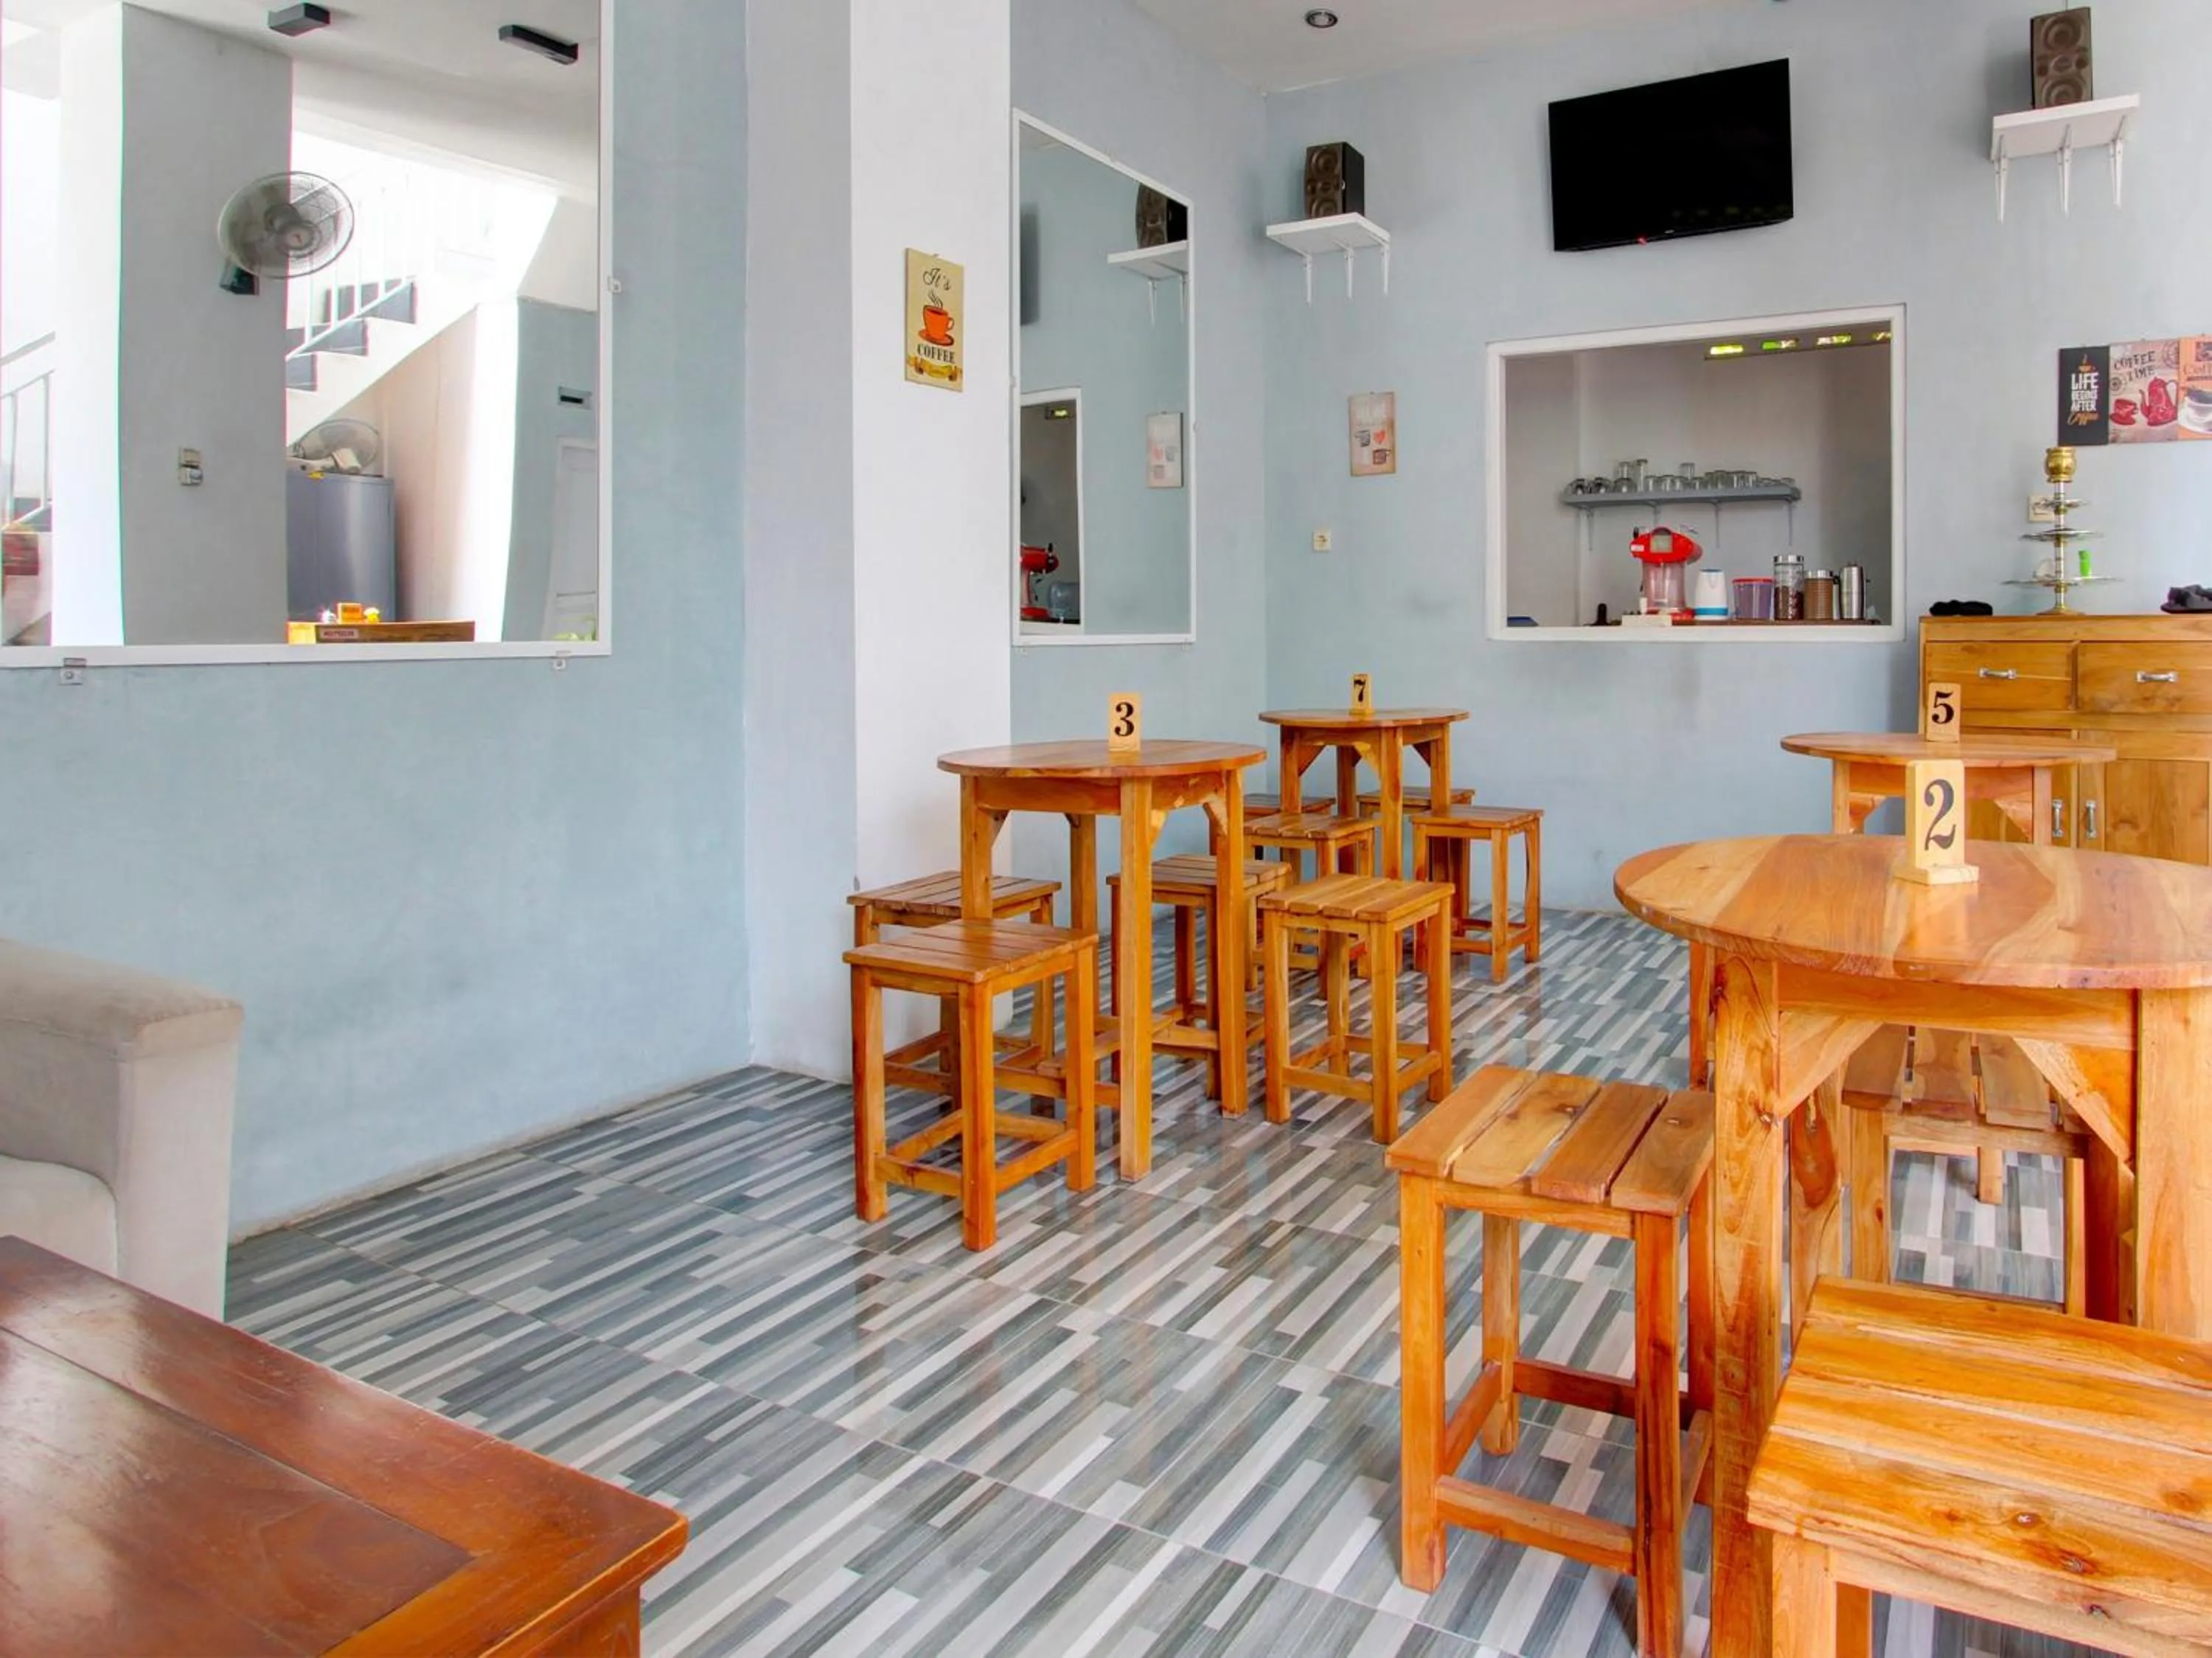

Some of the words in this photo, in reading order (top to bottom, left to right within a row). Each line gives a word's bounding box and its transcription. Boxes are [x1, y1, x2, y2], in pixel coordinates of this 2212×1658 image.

[917, 343, 956, 364] COFFEE
[2113, 350, 2155, 370] COFFEE
[2071, 372, 2099, 389] LIFE
[2126, 365, 2154, 381] TIME
[1353, 679, 1366, 703] 7
[1931, 690, 1955, 724] 5
[1114, 701, 1135, 737] 3
[1924, 779, 1957, 851] 2
